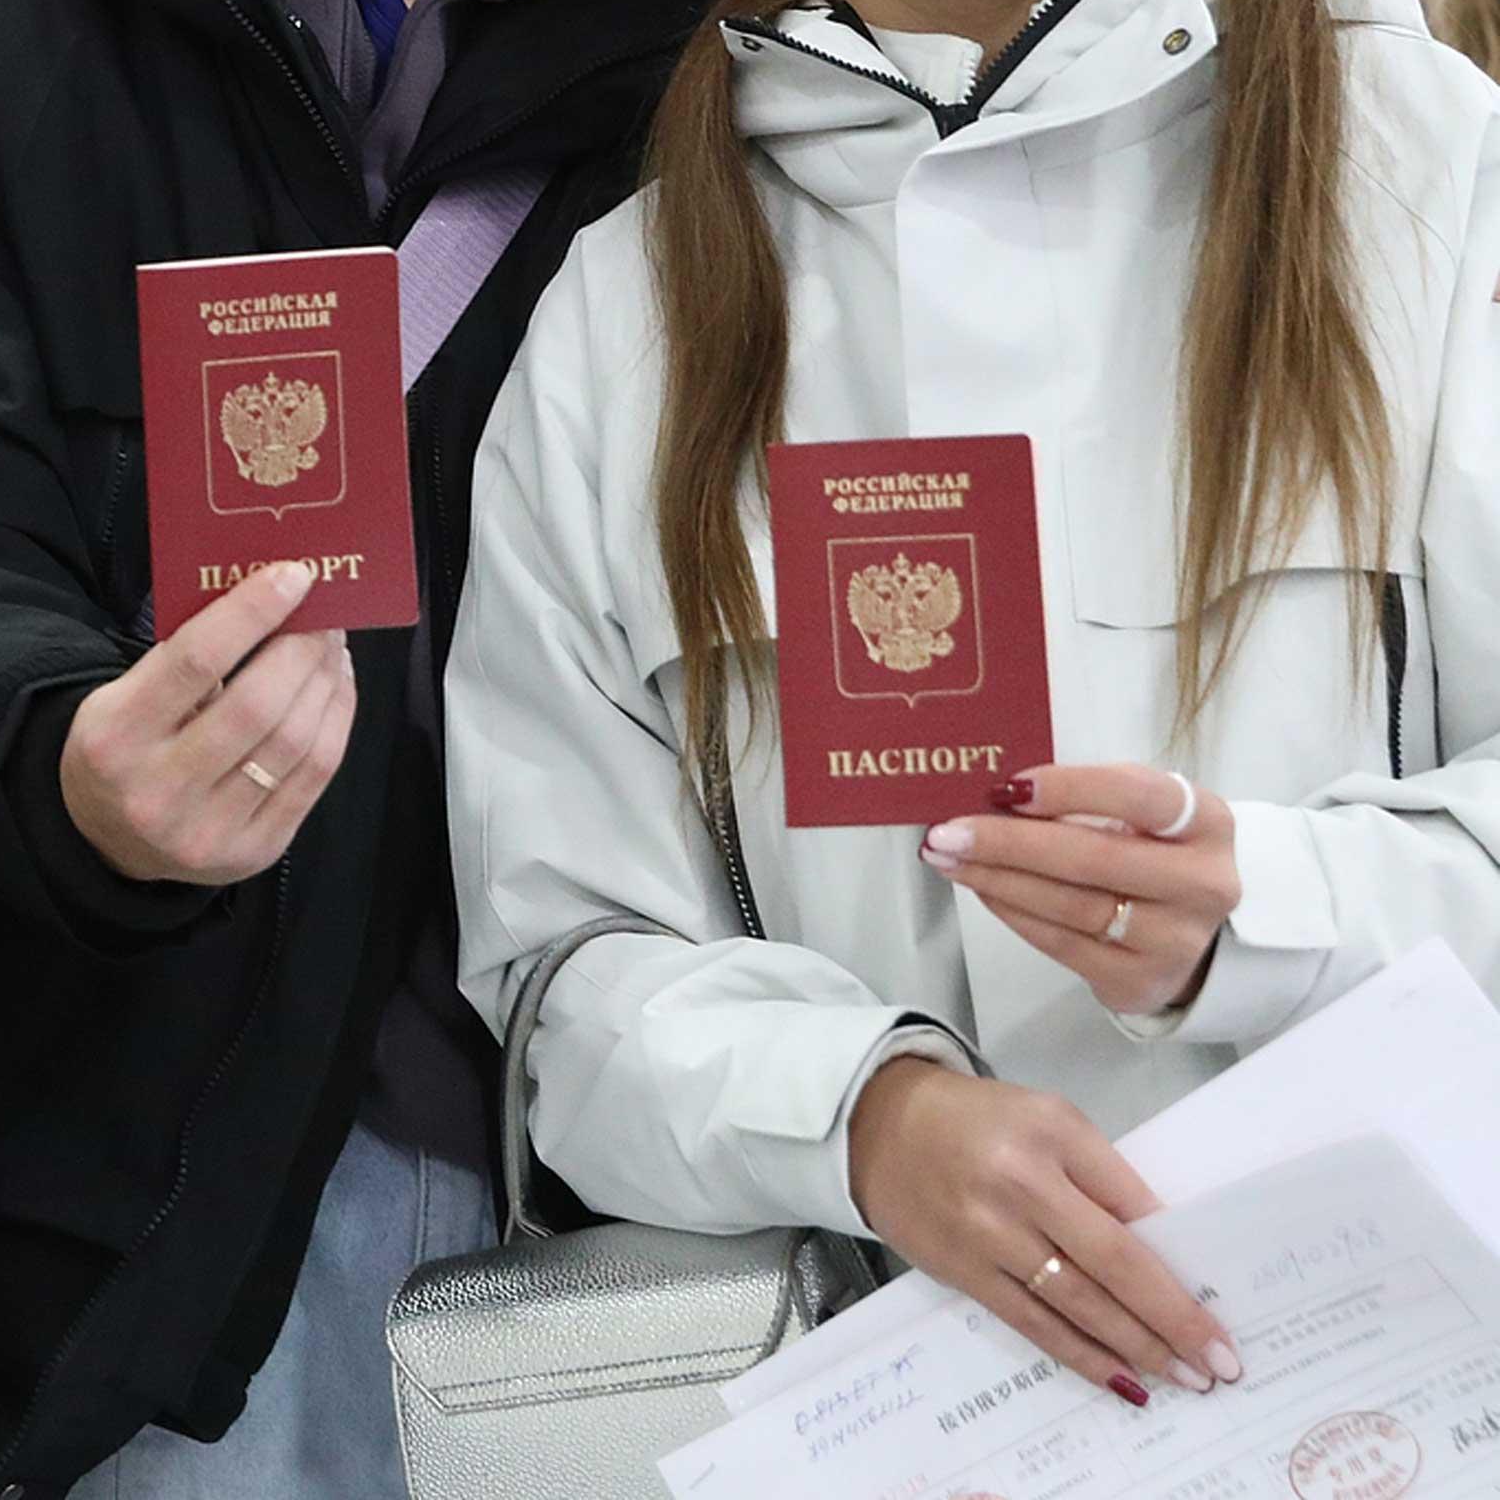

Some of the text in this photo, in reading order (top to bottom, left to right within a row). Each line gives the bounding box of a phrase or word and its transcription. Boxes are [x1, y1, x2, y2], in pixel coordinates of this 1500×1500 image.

[199, 291, 338, 319] РОССИЙСКАЯ
[208, 310, 330, 336] ФЕДЕРАЦИЯ
[823, 471, 970, 496] РОССИЙСКАЯ
[832, 491, 963, 514] ФЕДЕРАЦИЯ
[828, 744, 1003, 777] ПАСПОРТ
